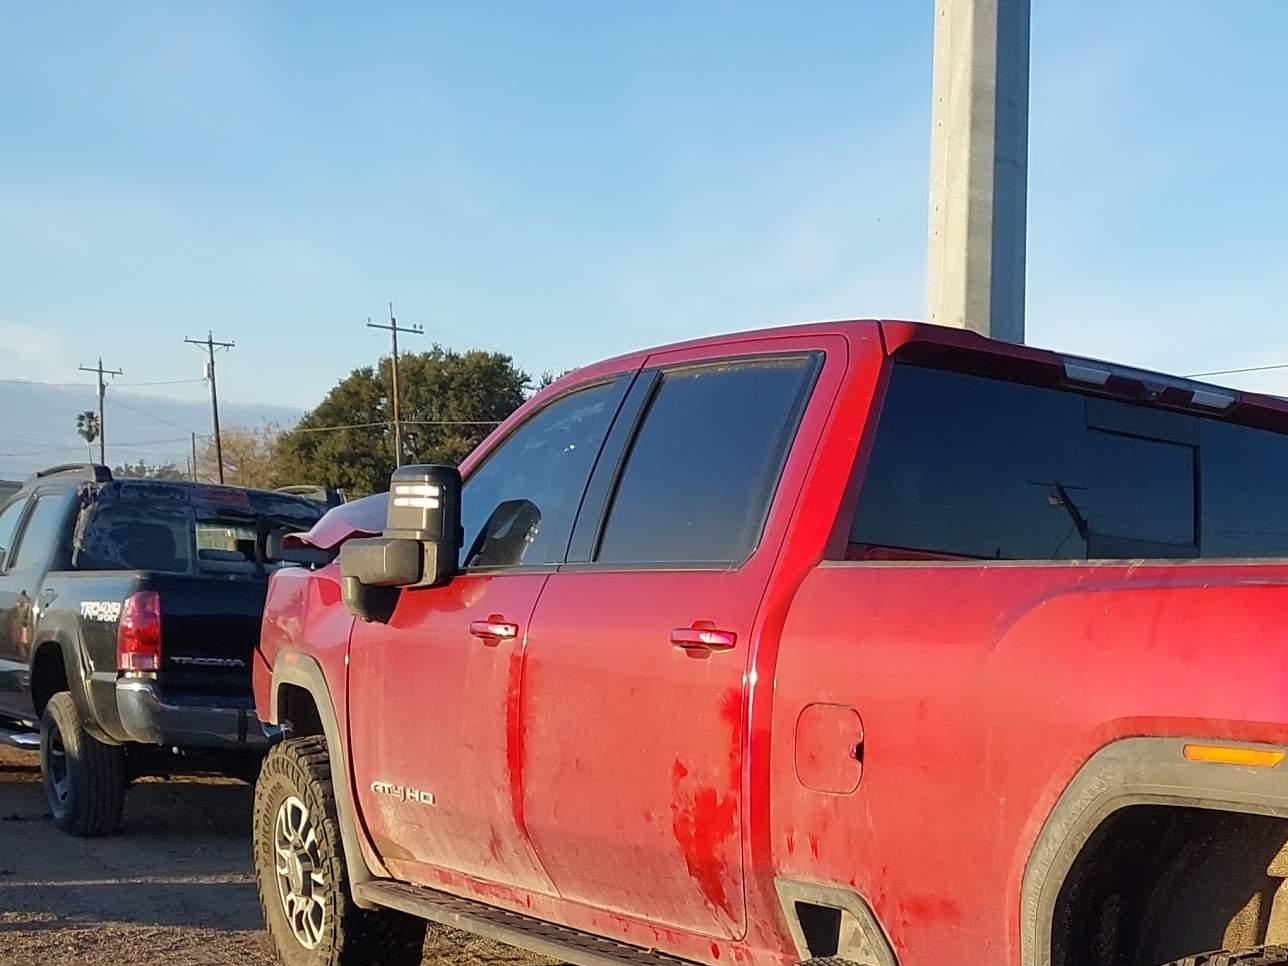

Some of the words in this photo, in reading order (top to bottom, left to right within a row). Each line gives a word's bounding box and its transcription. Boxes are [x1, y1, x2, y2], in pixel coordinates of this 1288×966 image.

[97, 614, 118, 623] SPORT
[169, 655, 246, 667] TACOMA
[406, 787, 436, 806] HD
